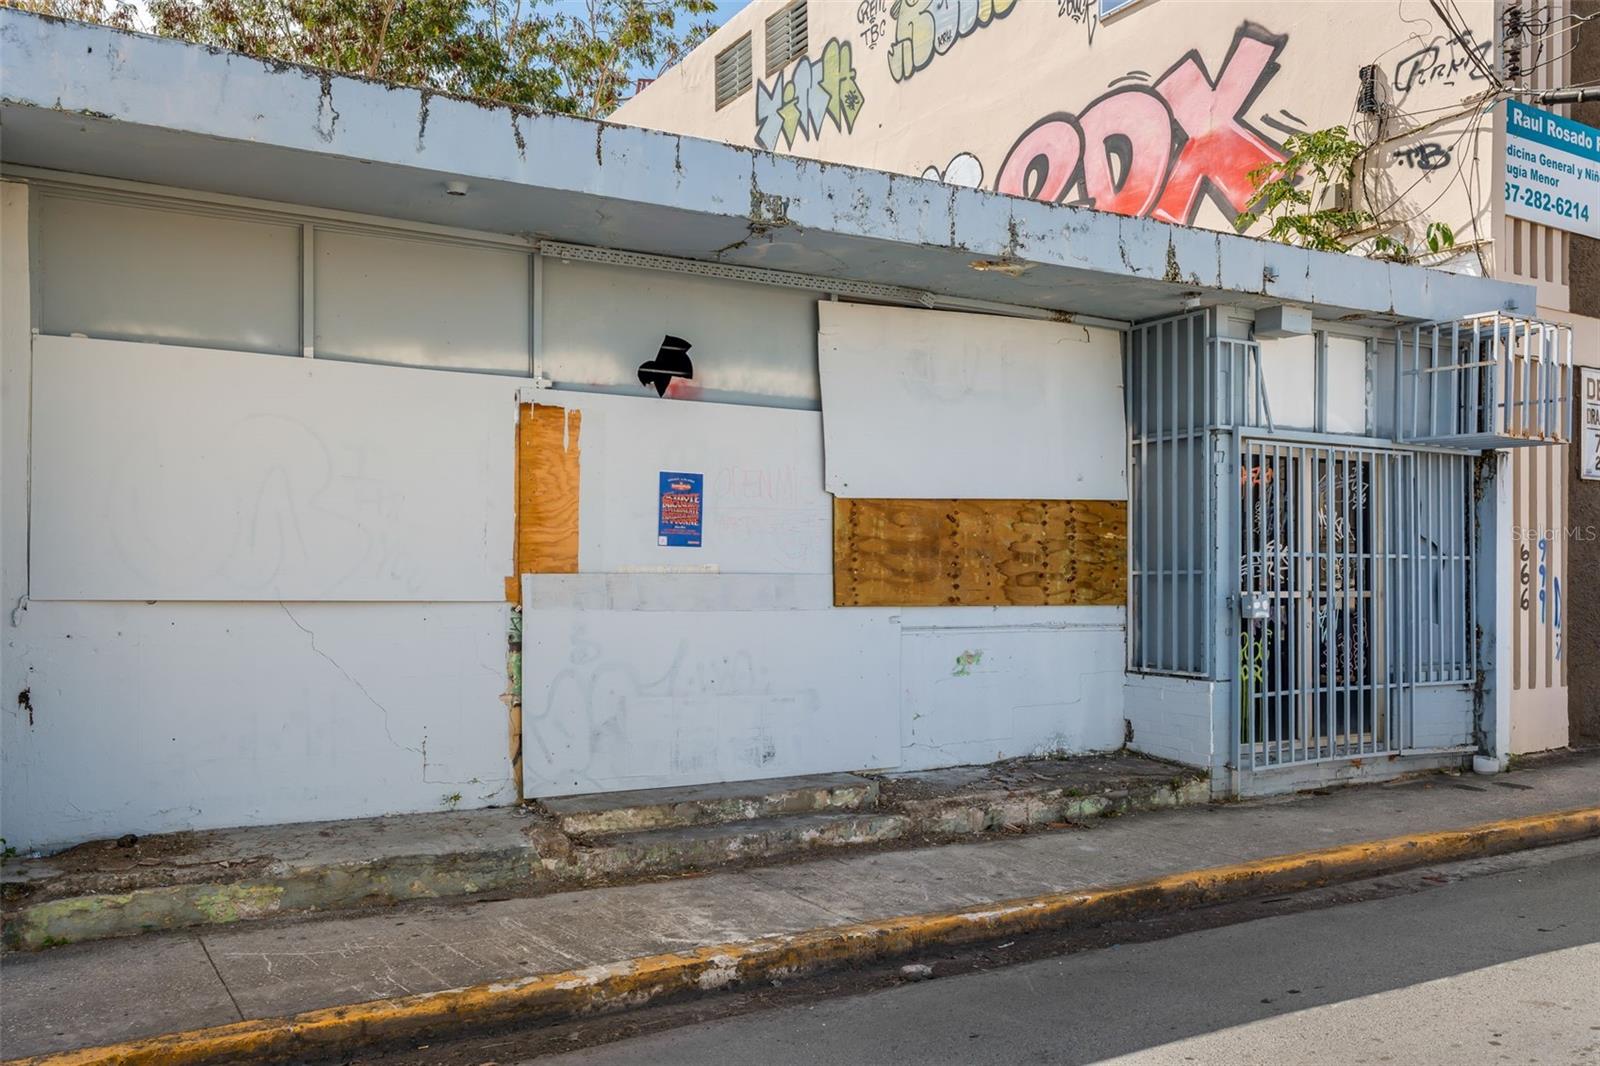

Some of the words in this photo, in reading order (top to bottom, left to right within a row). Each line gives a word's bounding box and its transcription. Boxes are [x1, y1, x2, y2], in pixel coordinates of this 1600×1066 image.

[860, 19, 886, 46] TBC
[1513, 107, 1543, 133] Raul
[1547, 119, 1593, 149] Rosado
[1530, 168, 1560, 187] Menor
[1539, 153, 1575, 175] General
[1577, 167, 1583, 180] y
